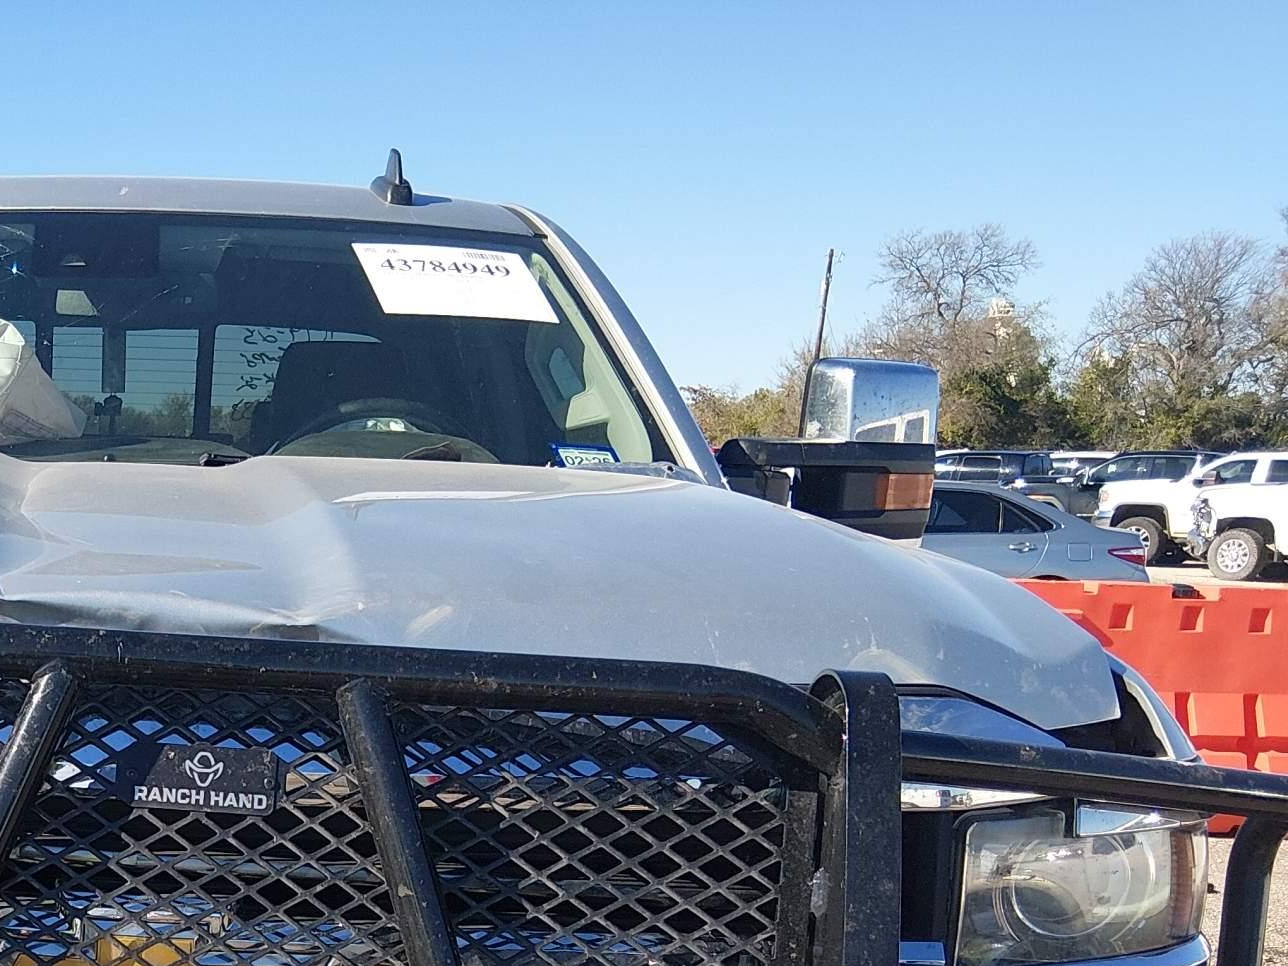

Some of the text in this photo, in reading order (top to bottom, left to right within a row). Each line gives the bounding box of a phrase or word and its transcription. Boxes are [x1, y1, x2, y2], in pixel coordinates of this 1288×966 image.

[380, 258, 510, 277] 43784949
[134, 785, 268, 810] RANCH HAND
